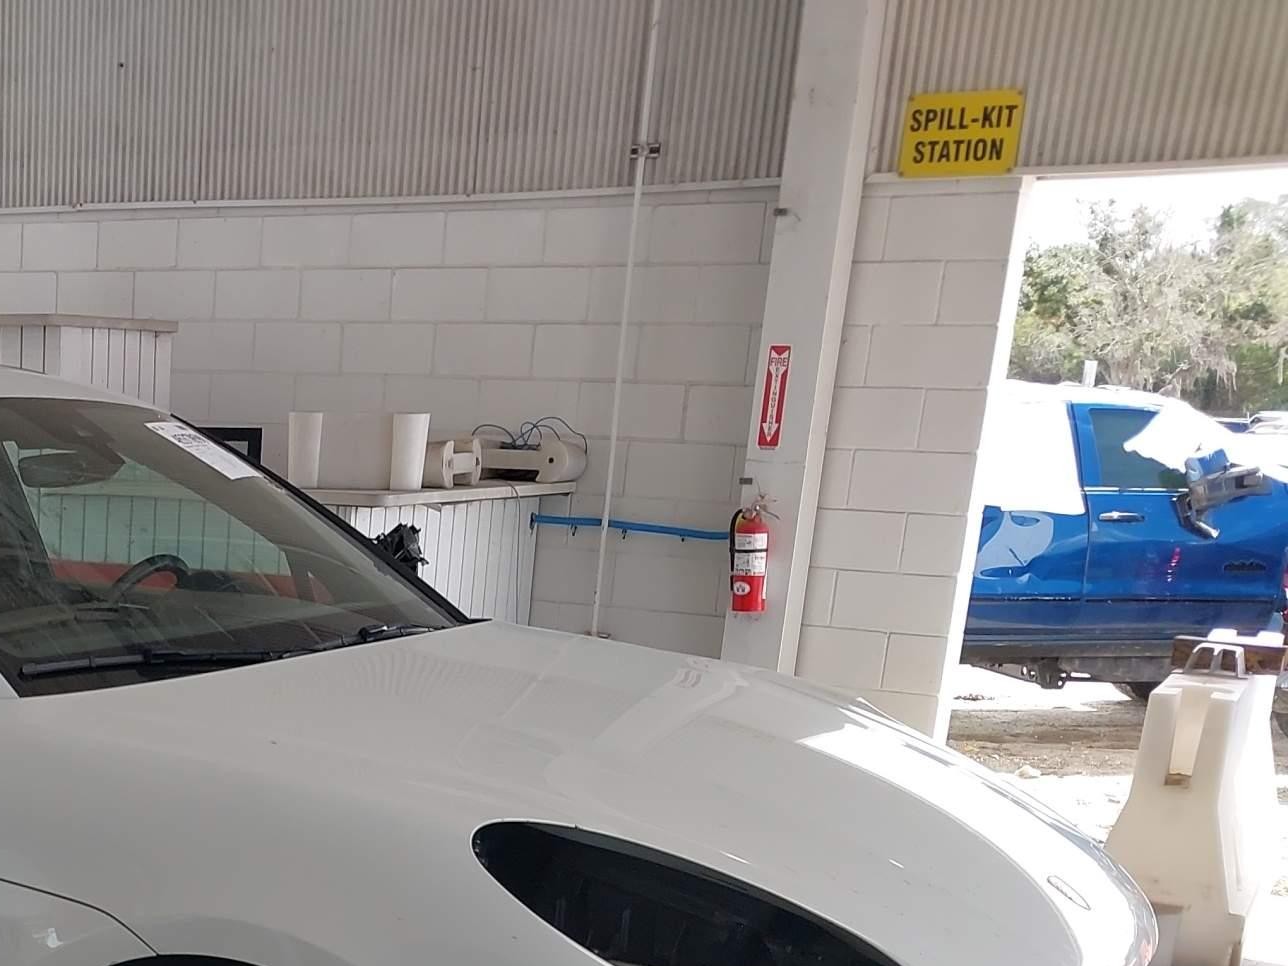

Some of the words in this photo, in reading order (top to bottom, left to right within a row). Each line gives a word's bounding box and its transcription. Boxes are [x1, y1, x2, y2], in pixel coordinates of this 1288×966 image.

[910, 104, 1019, 132] SPILL-KIT
[913, 138, 1004, 164] STATION
[770, 357, 788, 367] FIRE
